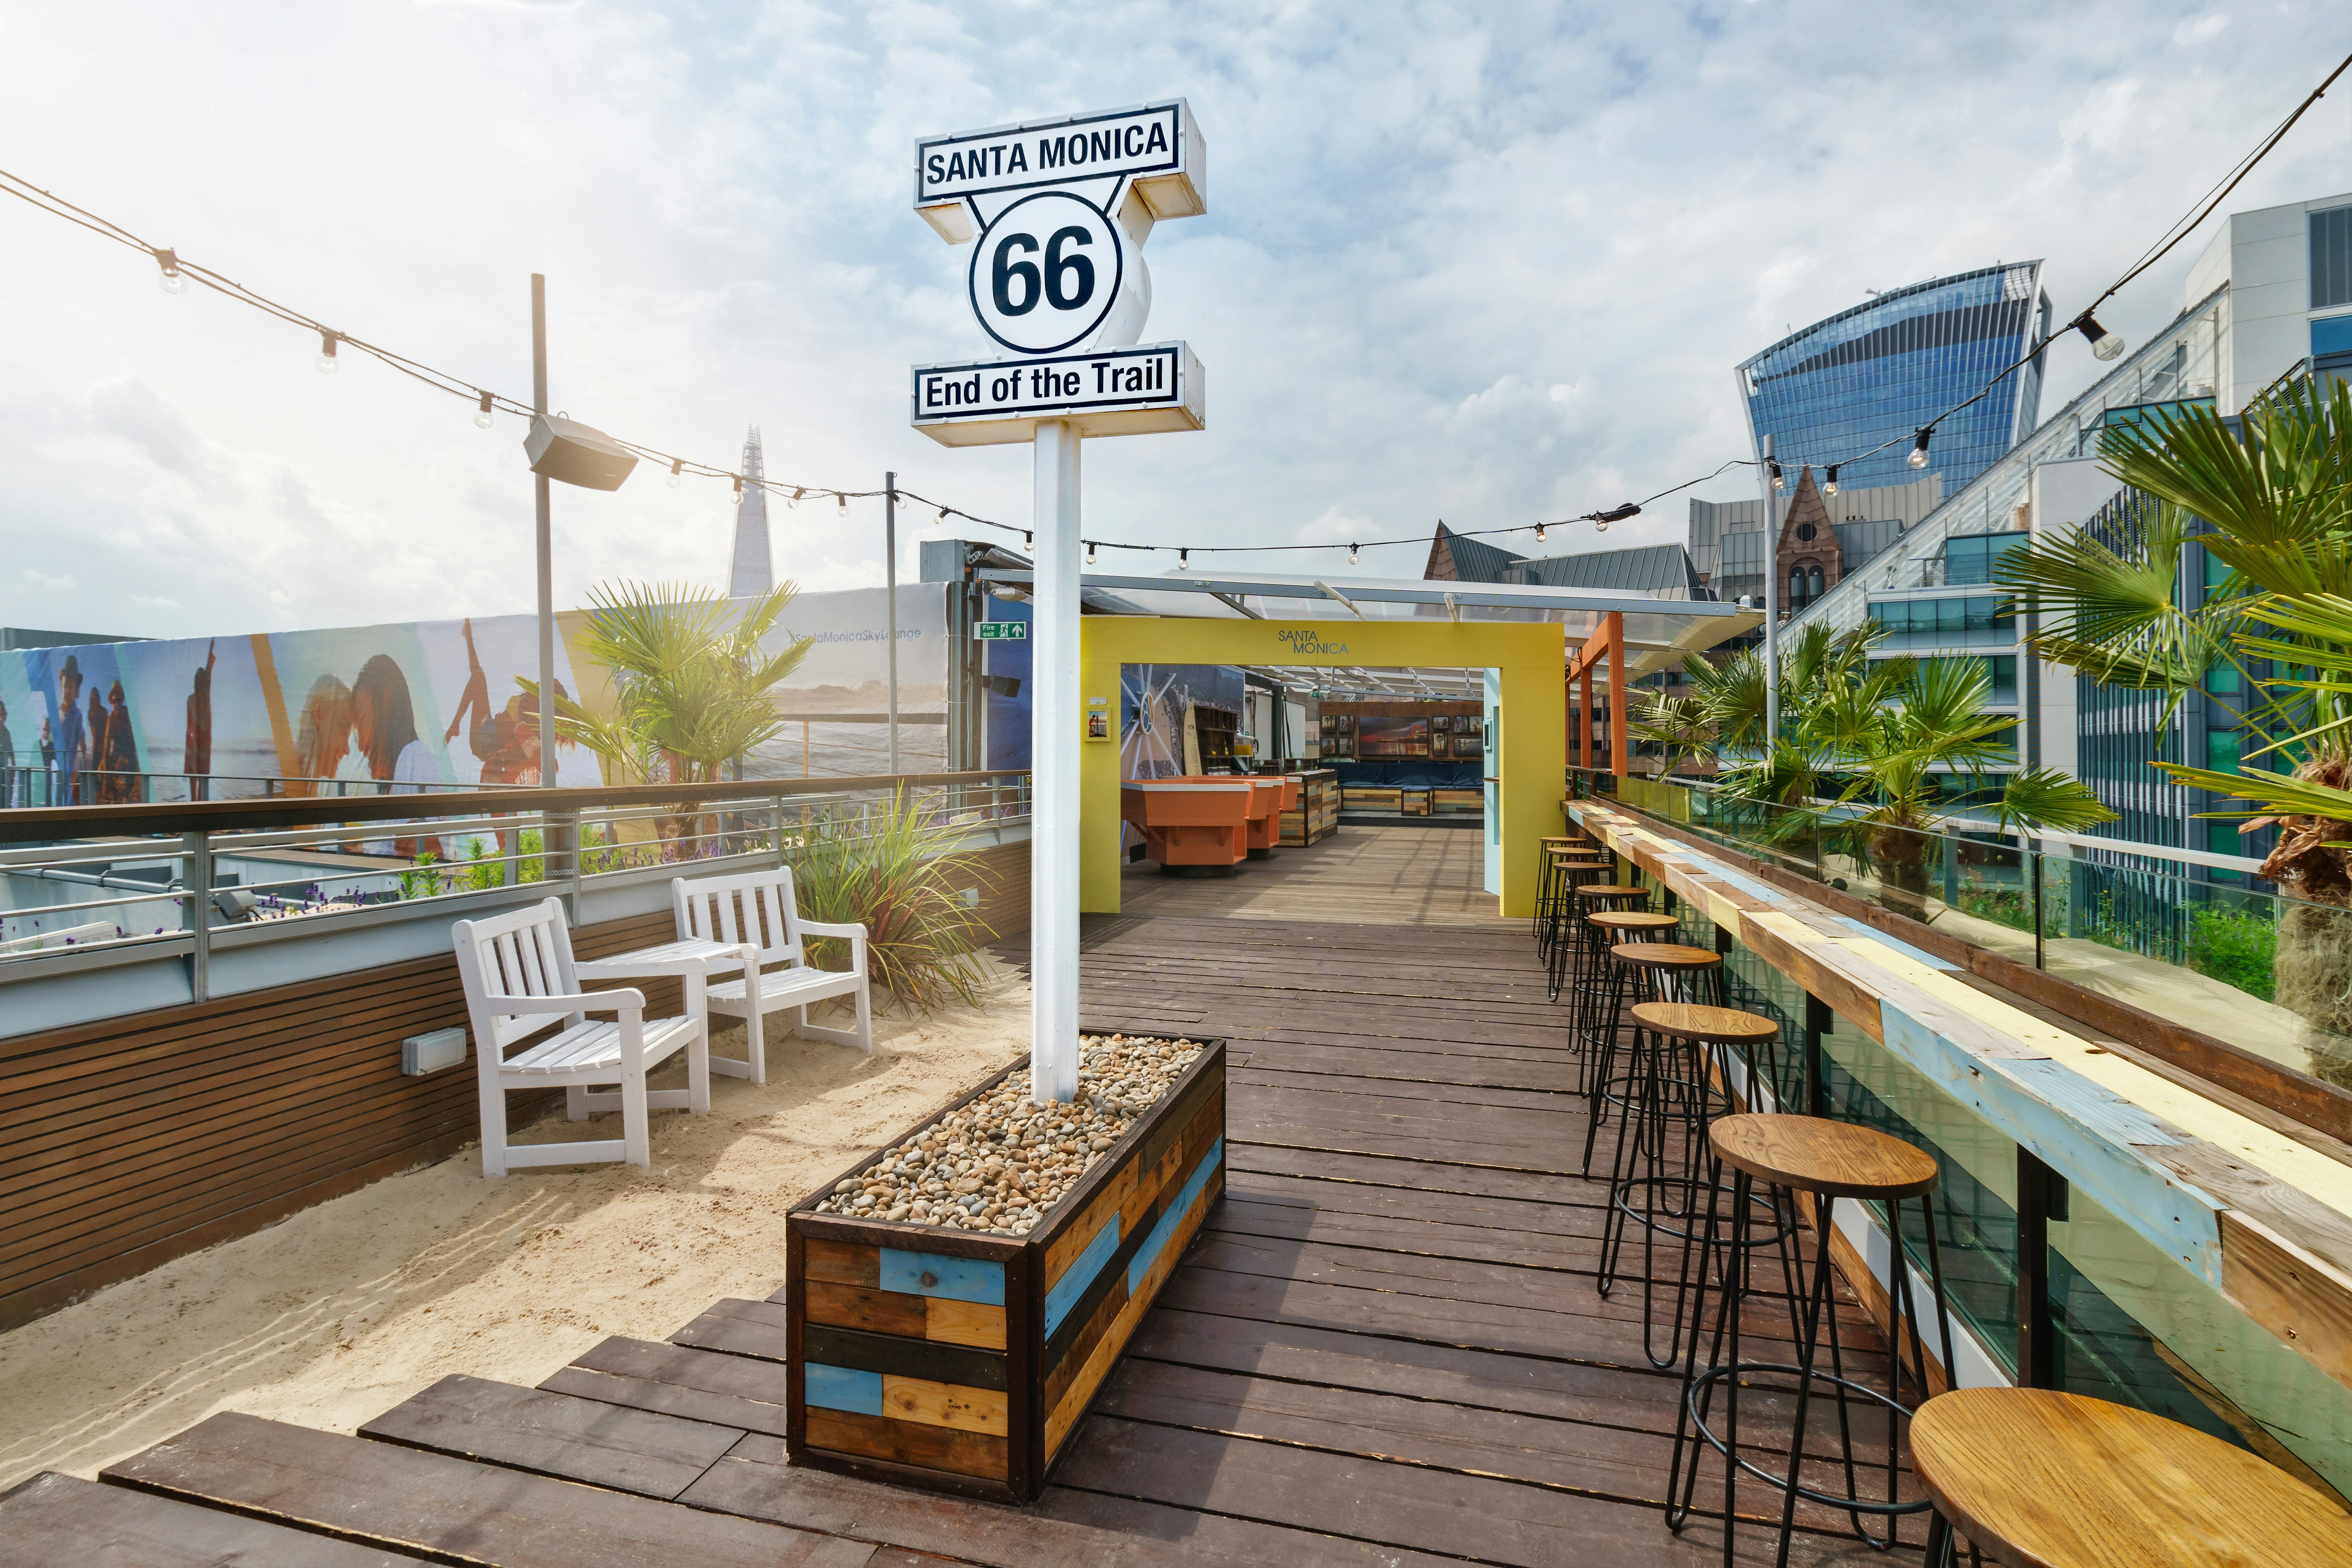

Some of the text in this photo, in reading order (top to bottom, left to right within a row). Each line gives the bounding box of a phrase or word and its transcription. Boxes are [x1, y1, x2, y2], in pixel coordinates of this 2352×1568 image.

[927, 122, 1168, 185] SANTA MONICA
[992, 225, 1095, 317] 66
[927, 357, 1163, 408] End of the Trail
[1278, 630, 1318, 642] SANTA
[1293, 642, 1349, 654] MONICA
